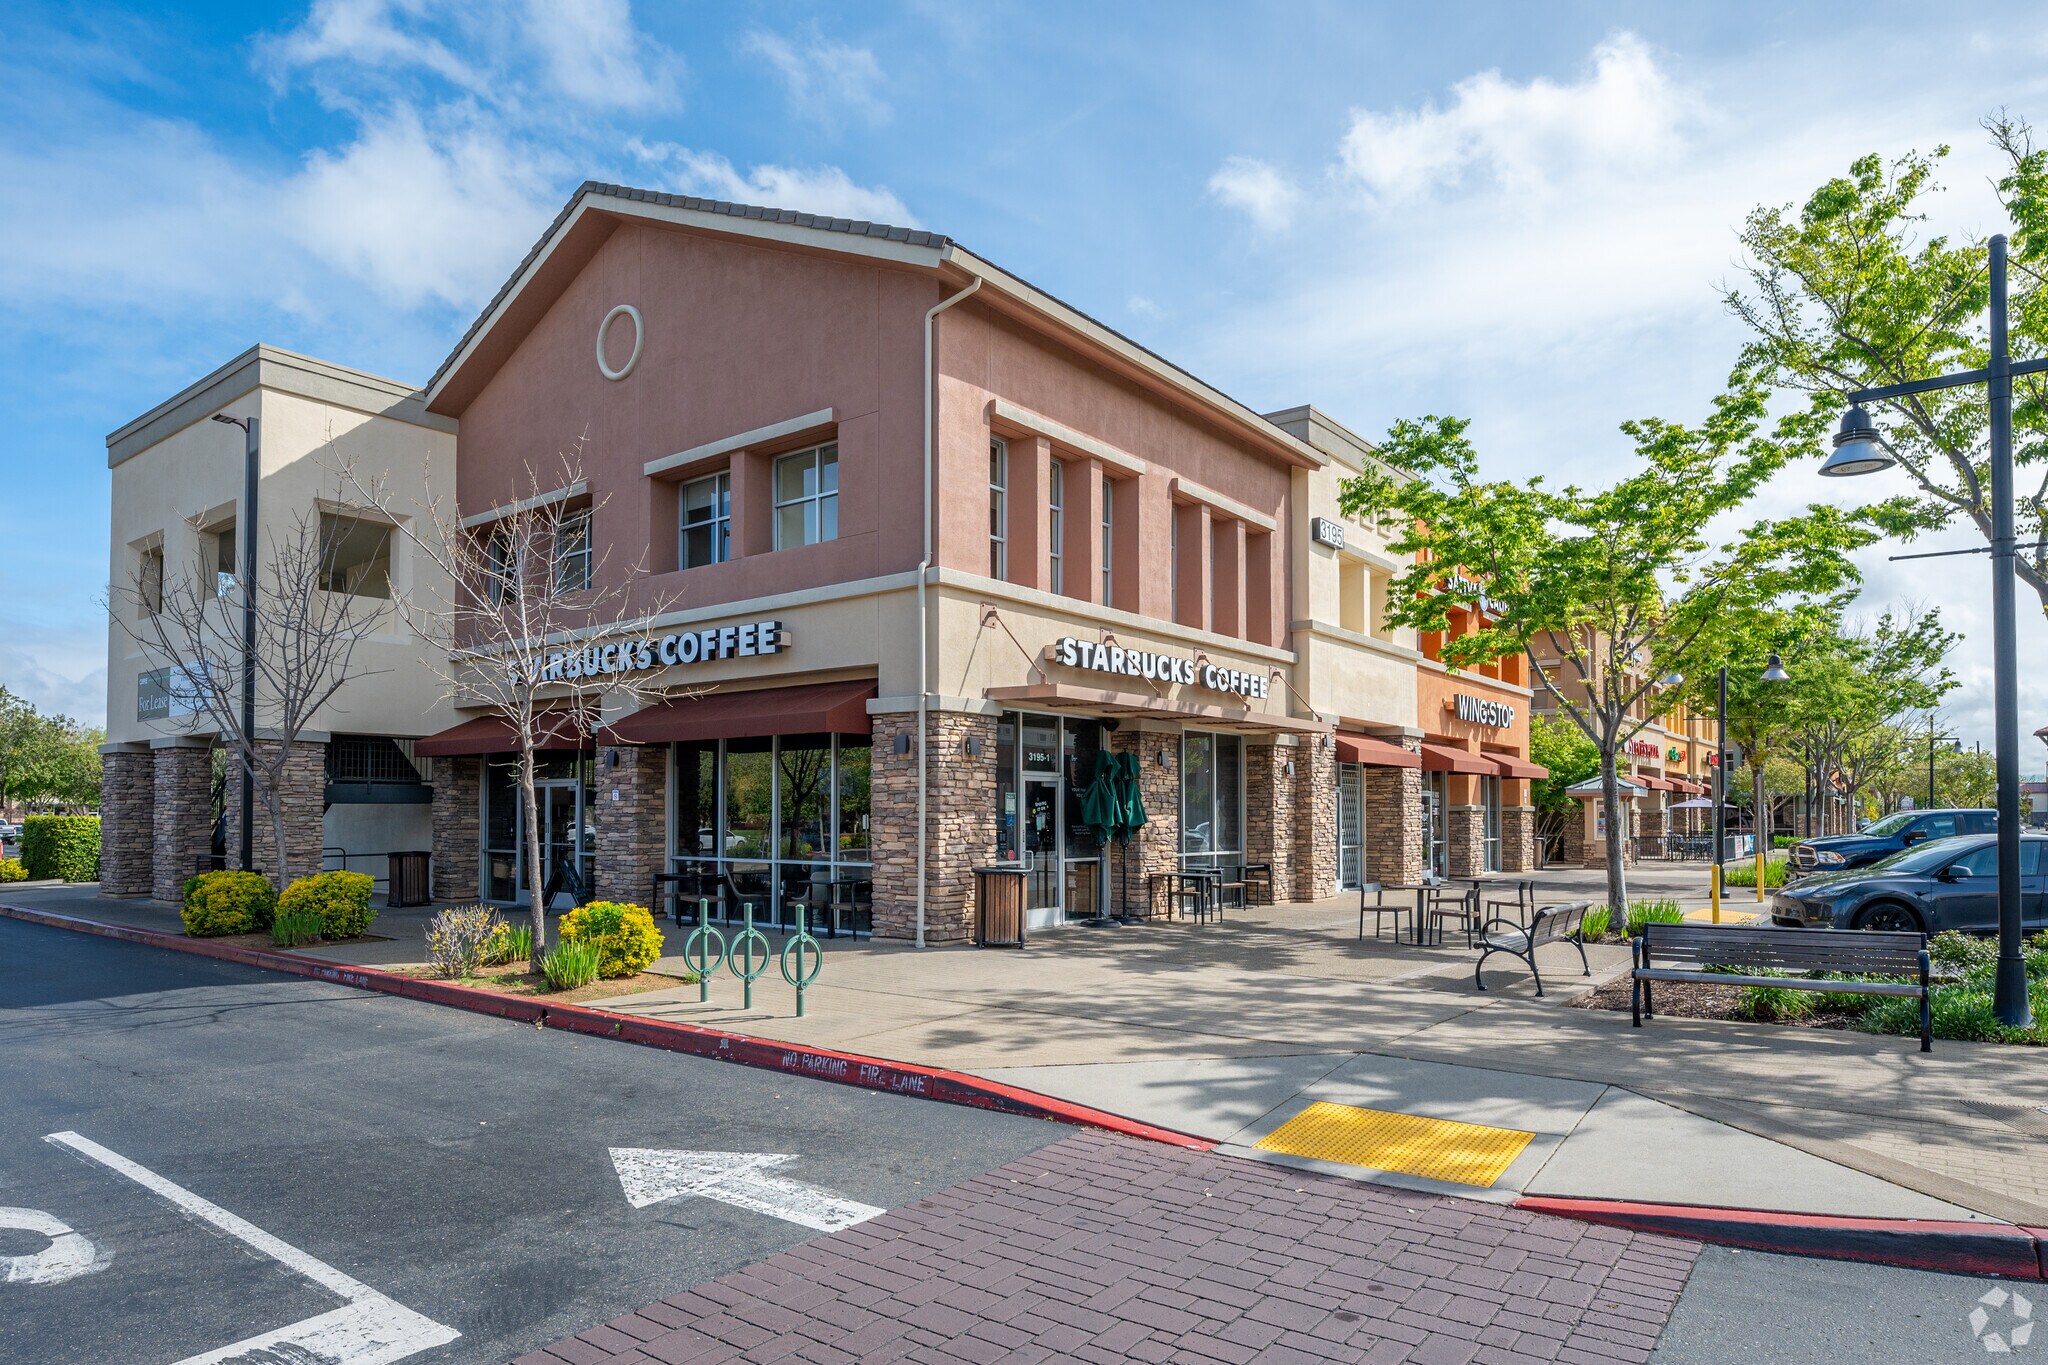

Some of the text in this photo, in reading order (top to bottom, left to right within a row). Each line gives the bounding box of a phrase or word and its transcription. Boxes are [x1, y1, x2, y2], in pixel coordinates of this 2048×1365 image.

[1320, 521, 1343, 546] 3195
[507, 621, 781, 686] SARBUCKS COFFEE
[1058, 637, 1269, 699] STARBUCKS COFFEE
[138, 694, 168, 712] For Lease
[1028, 752, 1050, 762] 3195-1
[801, 1053, 847, 1077] PARKING
[892, 1074, 926, 1093] LANE
